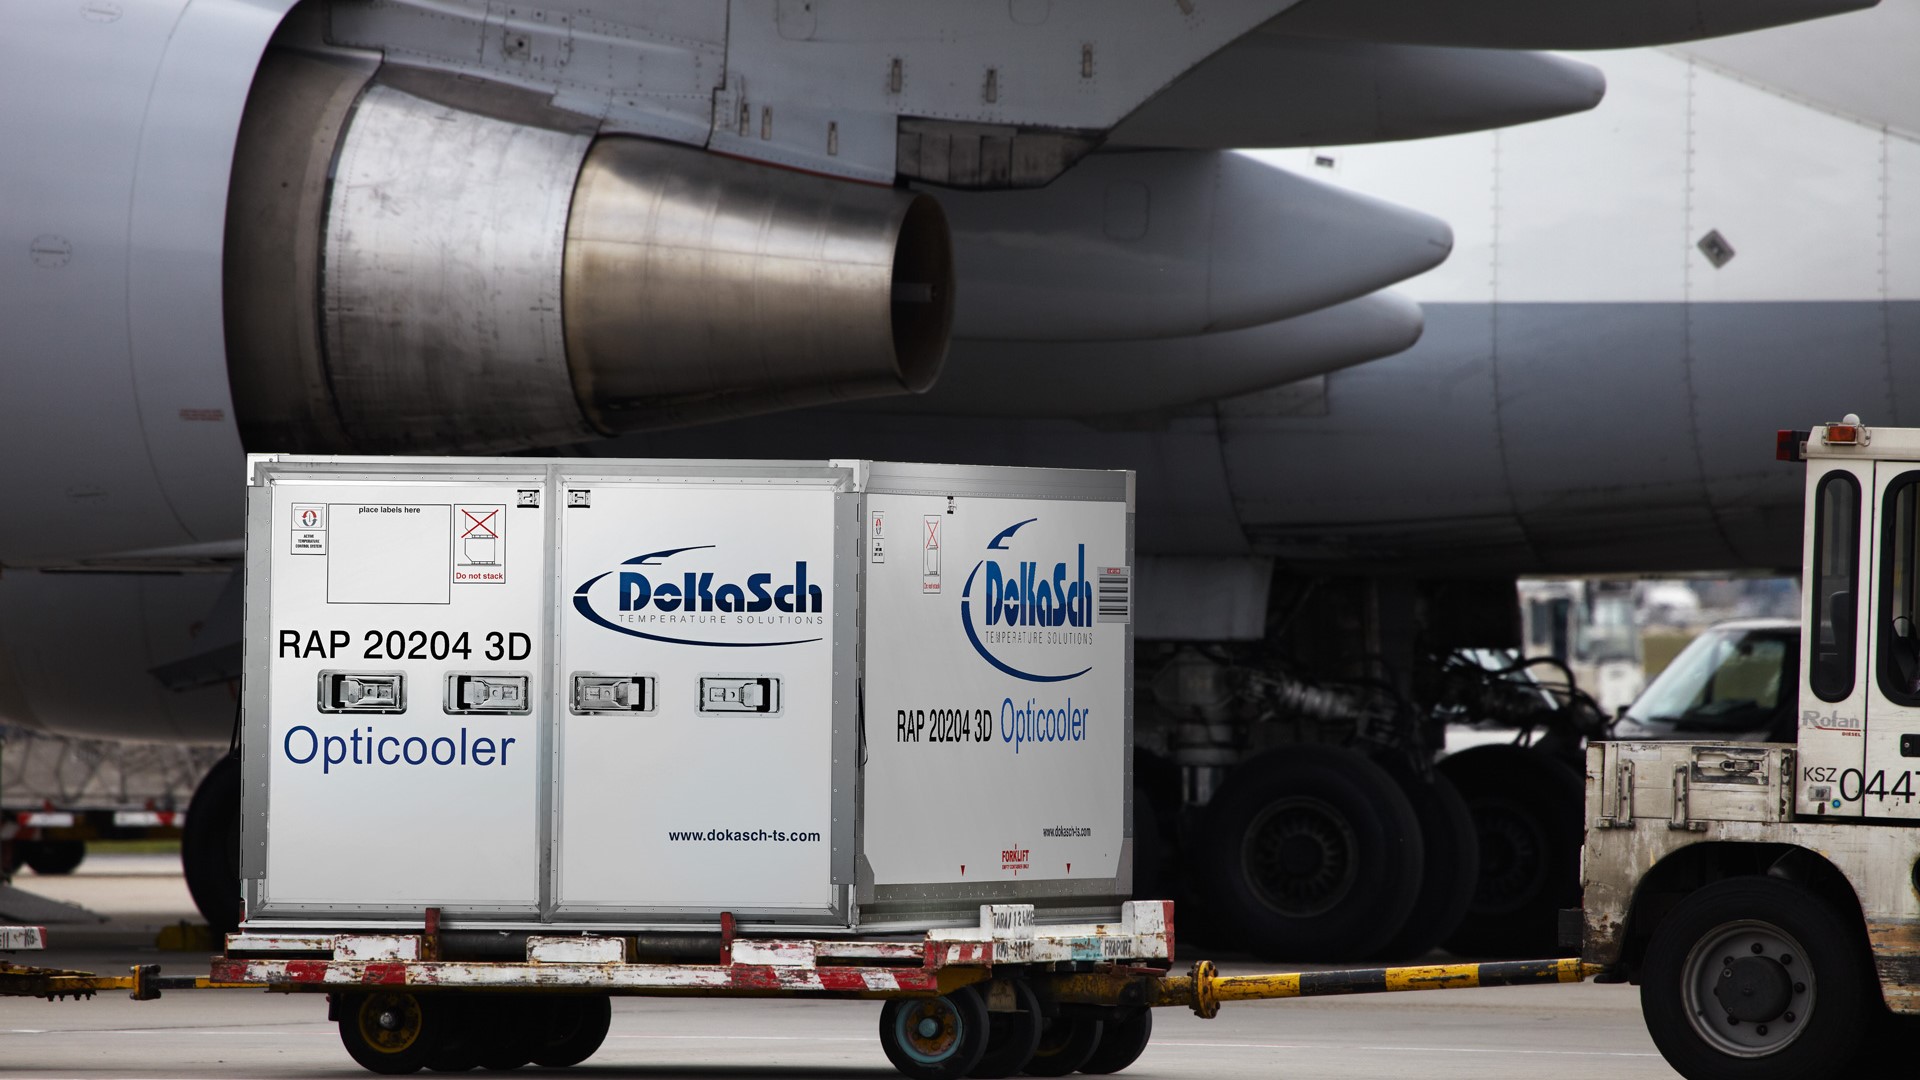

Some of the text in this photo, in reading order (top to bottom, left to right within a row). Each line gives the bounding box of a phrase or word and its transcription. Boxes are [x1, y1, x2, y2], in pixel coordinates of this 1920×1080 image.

[358, 505, 421, 515] place labels here
[456, 572, 504, 580] Do not stack
[619, 561, 823, 613] DoKaSch
[985, 543, 1093, 627] DoKaSch
[619, 614, 823, 625] TEMPERATURE SOLUTIONS
[279, 629, 532, 661] RAP 20204 3D
[985, 631, 1093, 646] TEMPERATURE SOLUTIONS
[897, 708, 993, 743] RAP 20204 3D
[1000, 697, 1089, 754] Opticooler
[284, 725, 516, 774] Opticooler
[1803, 767, 1837, 782] KSZ
[1839, 768, 1920, 804] 044
[668, 829, 821, 842] www.dokasch-ts.com
[1043, 825, 1091, 837] www.dokasch-ts.com
[1001, 850, 1030, 862] FORKLIFT
